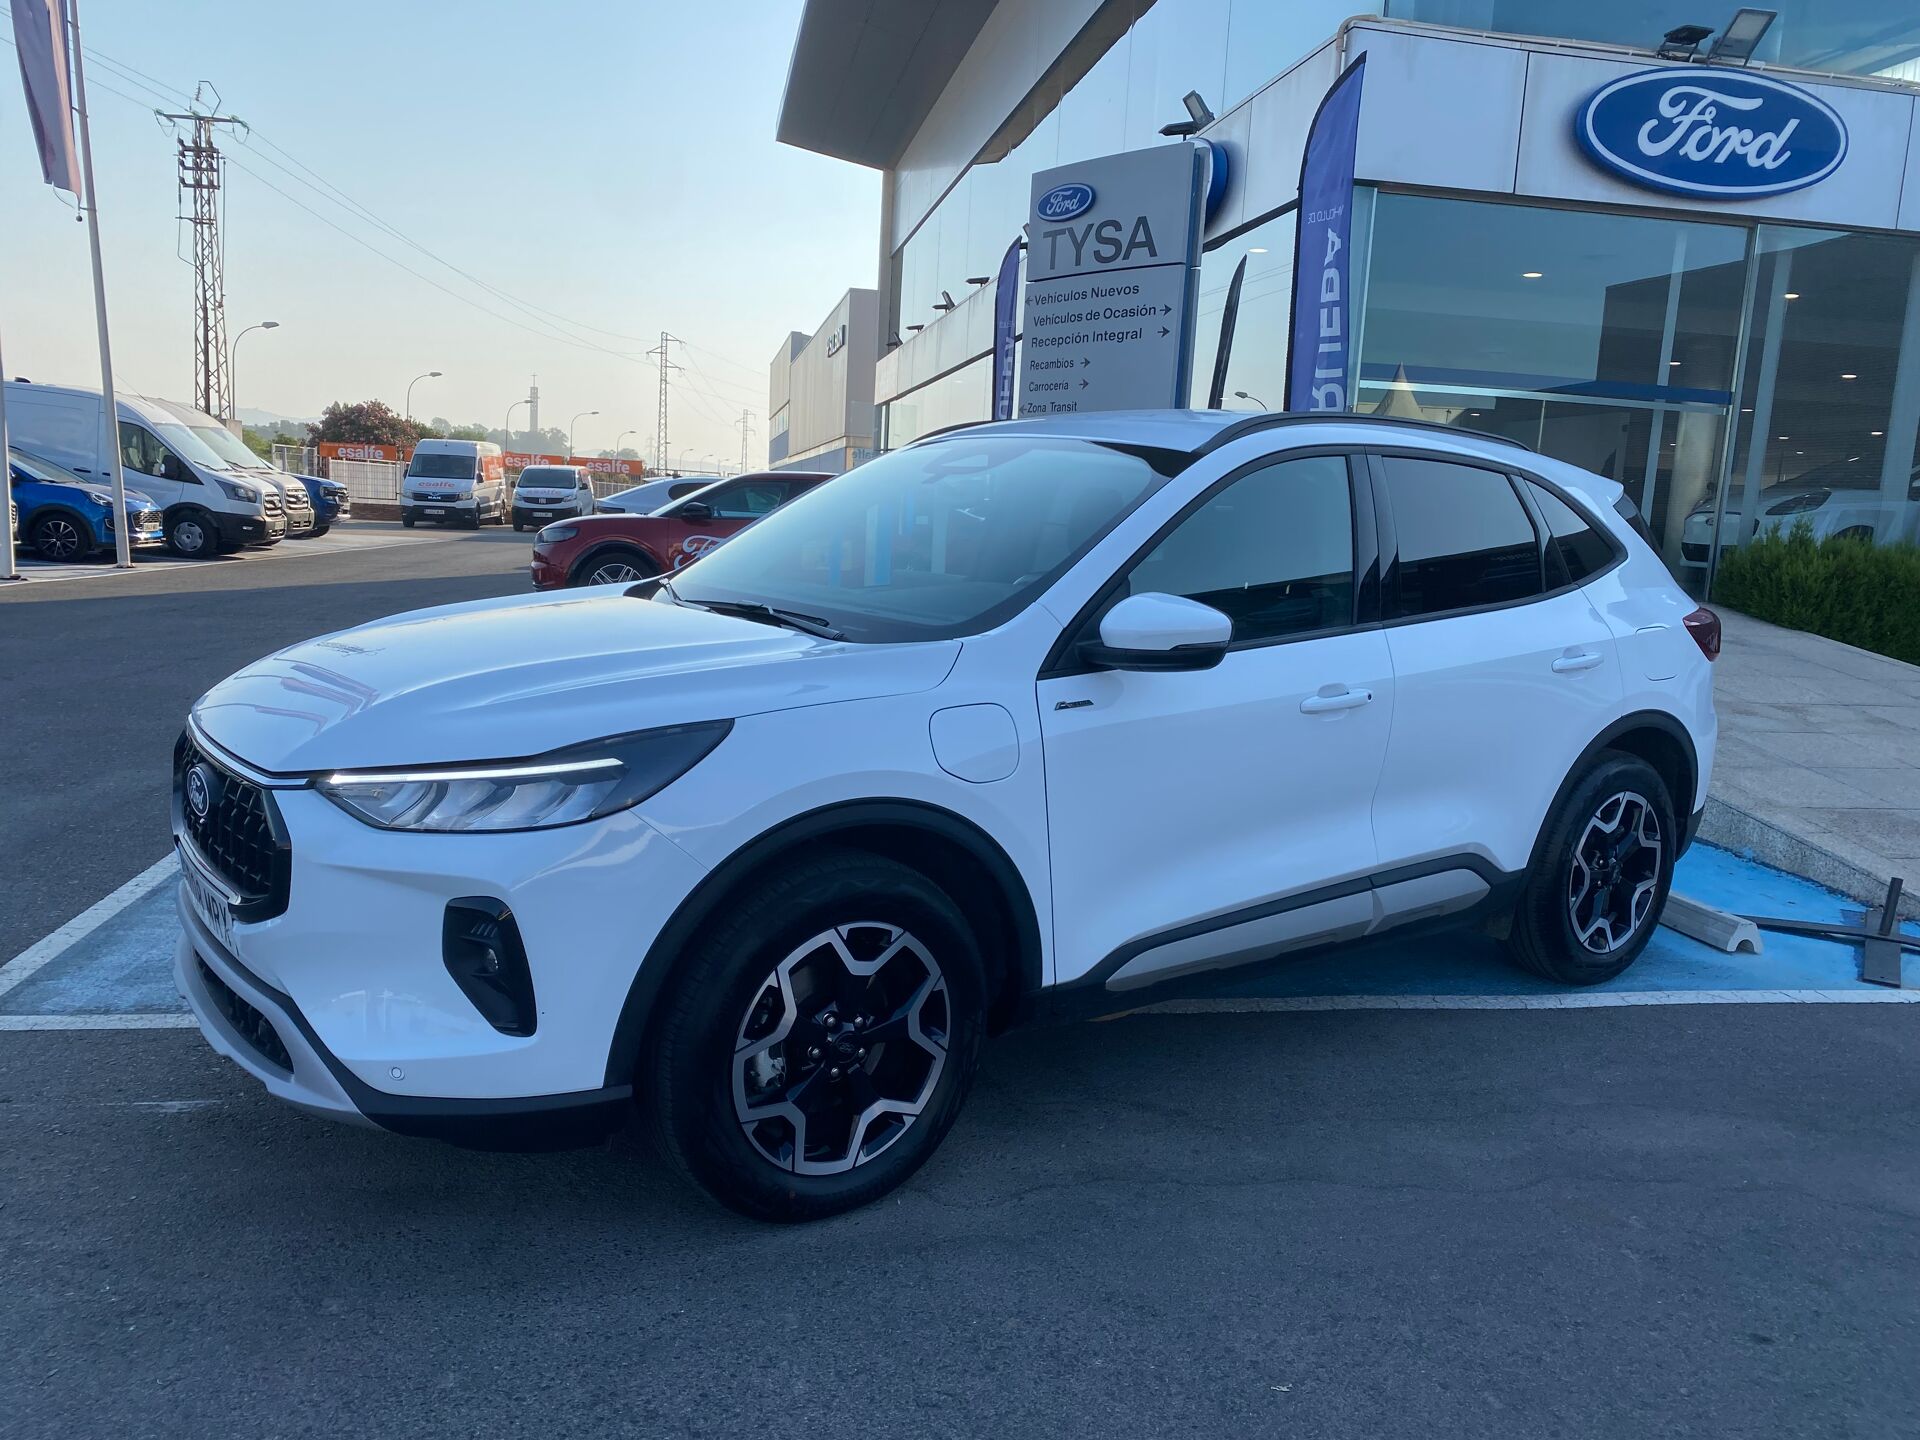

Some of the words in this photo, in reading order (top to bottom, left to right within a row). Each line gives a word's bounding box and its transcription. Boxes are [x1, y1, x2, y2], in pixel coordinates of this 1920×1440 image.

[1638, 85, 1800, 169] Ford
[1046, 190, 1080, 214] Ford
[1043, 216, 1157, 270] TYSA
[1091, 284, 1139, 299] Nuevos
[1033, 311, 1083, 327] Vehículos
[1085, 309, 1101, 321] de
[1103, 305, 1157, 319] Ocasión
[1031, 332, 1089, 348] Recepción
[1092, 327, 1143, 343] Integral
[1029, 358, 1075, 371] Recambios
[1027, 402, 1047, 414] Zona
[1050, 401, 1078, 413] Transit
[337, 445, 384, 460] esalfe
[505, 454, 549, 466] esalfe
[586, 459, 630, 474] esalfe
[418, 480, 456, 489] esalfe
